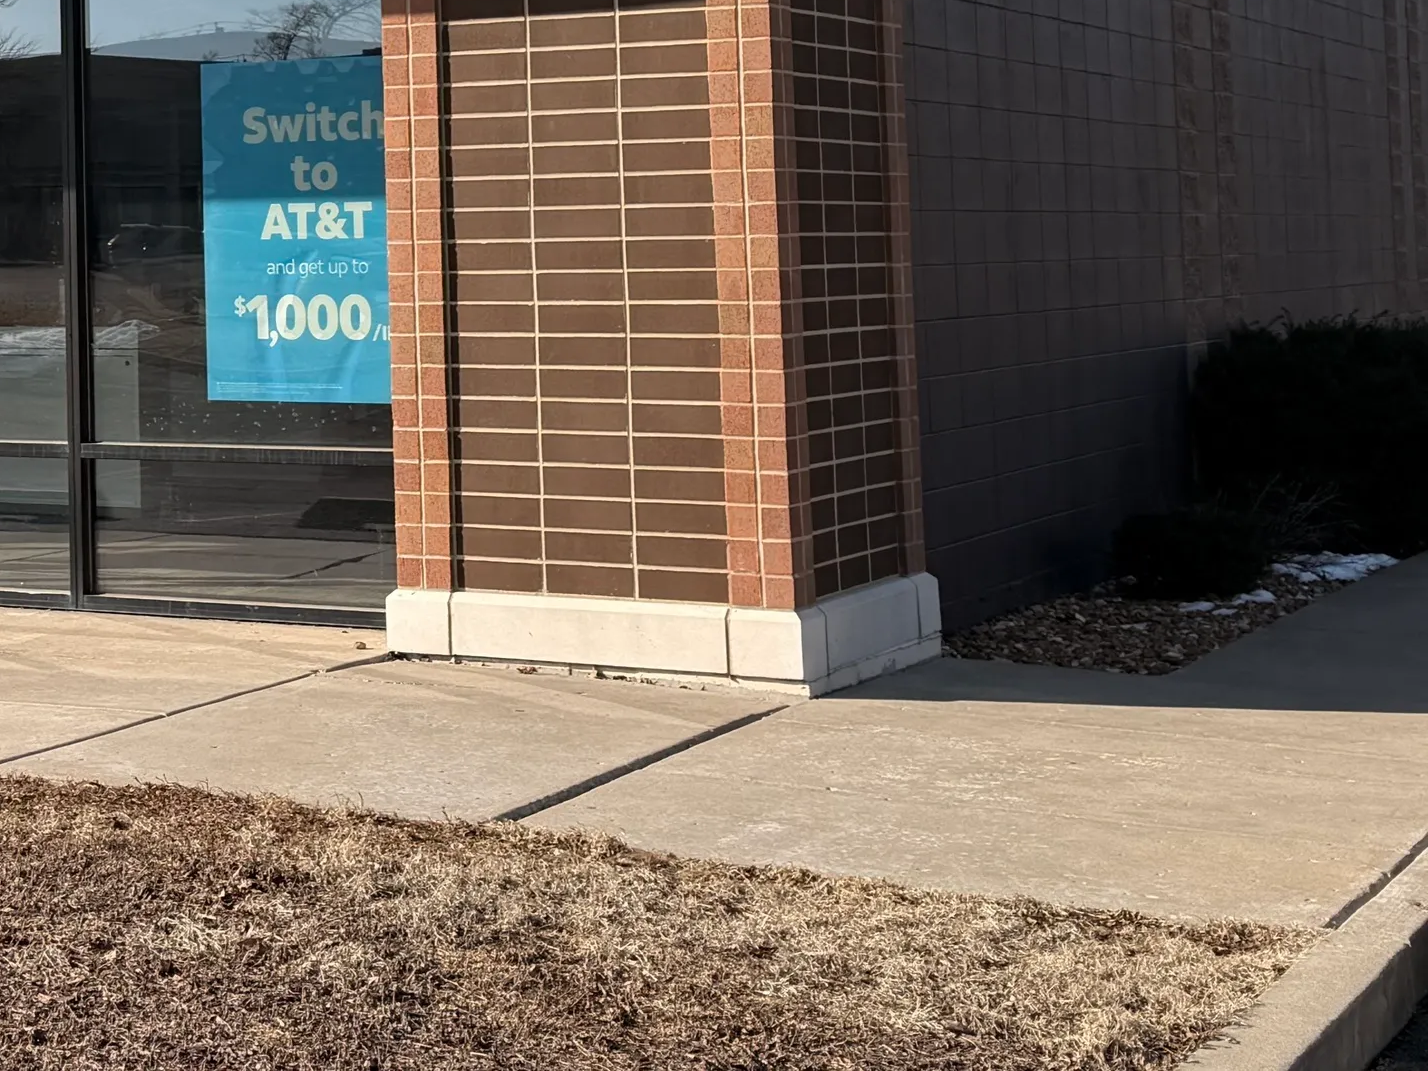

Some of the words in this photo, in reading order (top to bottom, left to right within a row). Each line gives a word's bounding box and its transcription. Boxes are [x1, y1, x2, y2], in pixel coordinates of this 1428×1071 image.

[242, 100, 383, 145] Switch
[291, 155, 338, 191] to
[260, 201, 372, 240] AT&T
[267, 259, 295, 275] and
[299, 260, 324, 278] get
[328, 261, 349, 279] up
[352, 259, 369, 274] to
